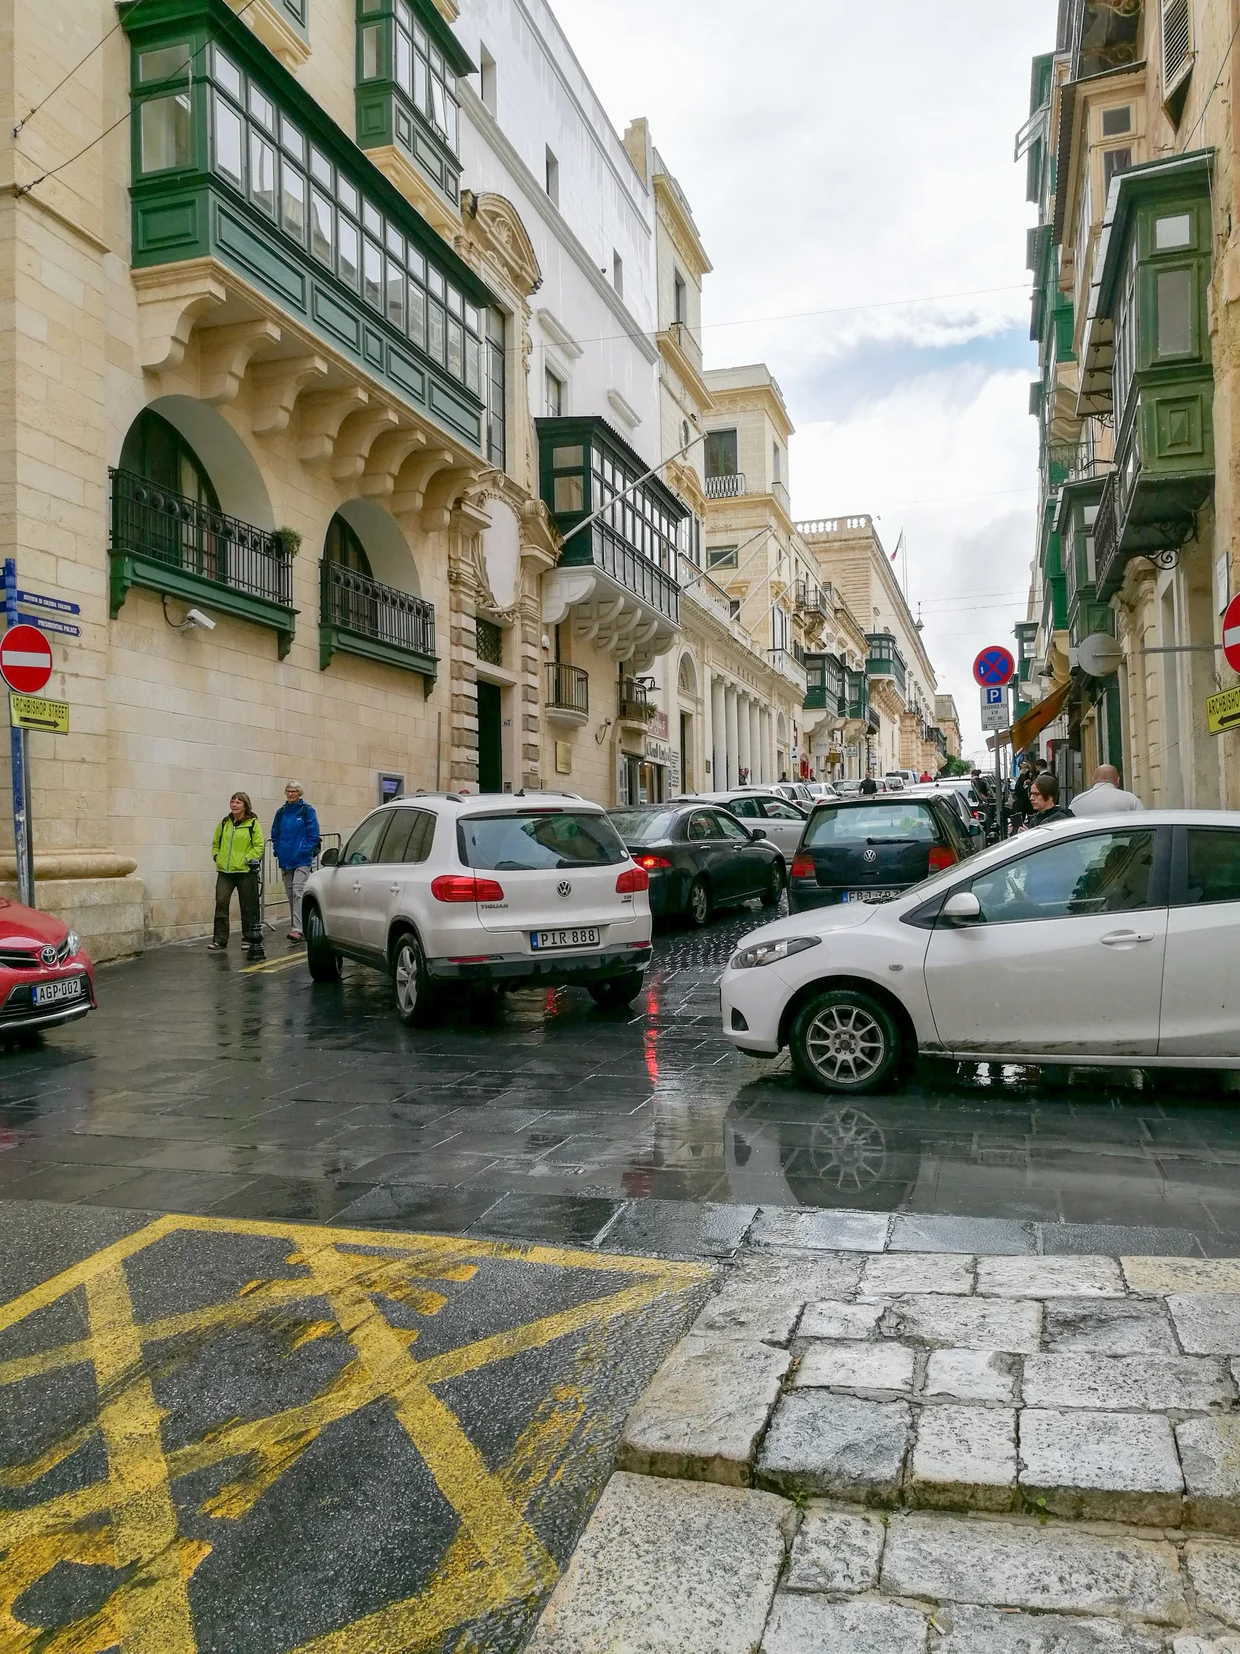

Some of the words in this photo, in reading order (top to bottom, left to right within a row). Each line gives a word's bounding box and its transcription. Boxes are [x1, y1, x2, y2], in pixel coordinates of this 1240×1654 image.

[37, 619, 63, 631] PRESIDENTIAL
[63, 625, 78, 634] PALACE
[990, 689, 999, 703] P
[1208, 689, 1240, 717] ARCHBISHO
[12, 697, 46, 716] ARCHBISHOP
[48, 702, 68, 720] STREET
[540, 931, 567, 946] PIR
[571, 929, 596, 943] 888
